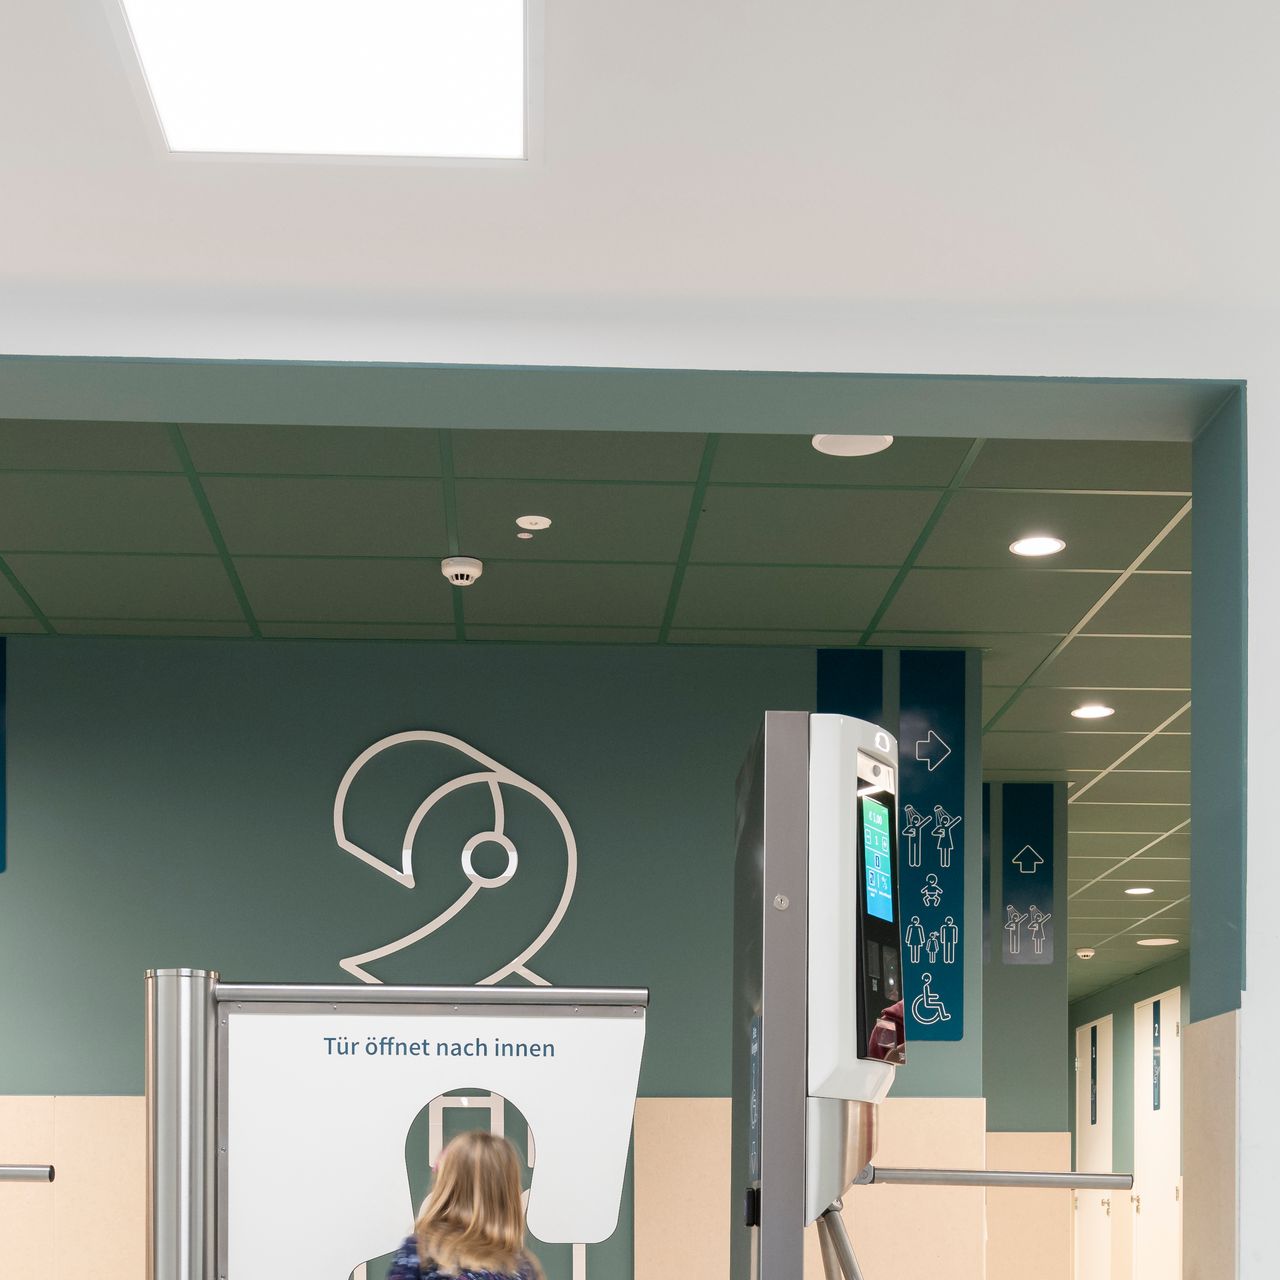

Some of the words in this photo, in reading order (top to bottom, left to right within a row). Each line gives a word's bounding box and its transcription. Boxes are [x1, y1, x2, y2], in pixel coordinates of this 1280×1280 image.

[323, 1036, 360, 1056] Tür
[365, 1036, 430, 1056] öffnet
[436, 1037, 488, 1057] nach
[494, 1038, 555, 1057] innen
